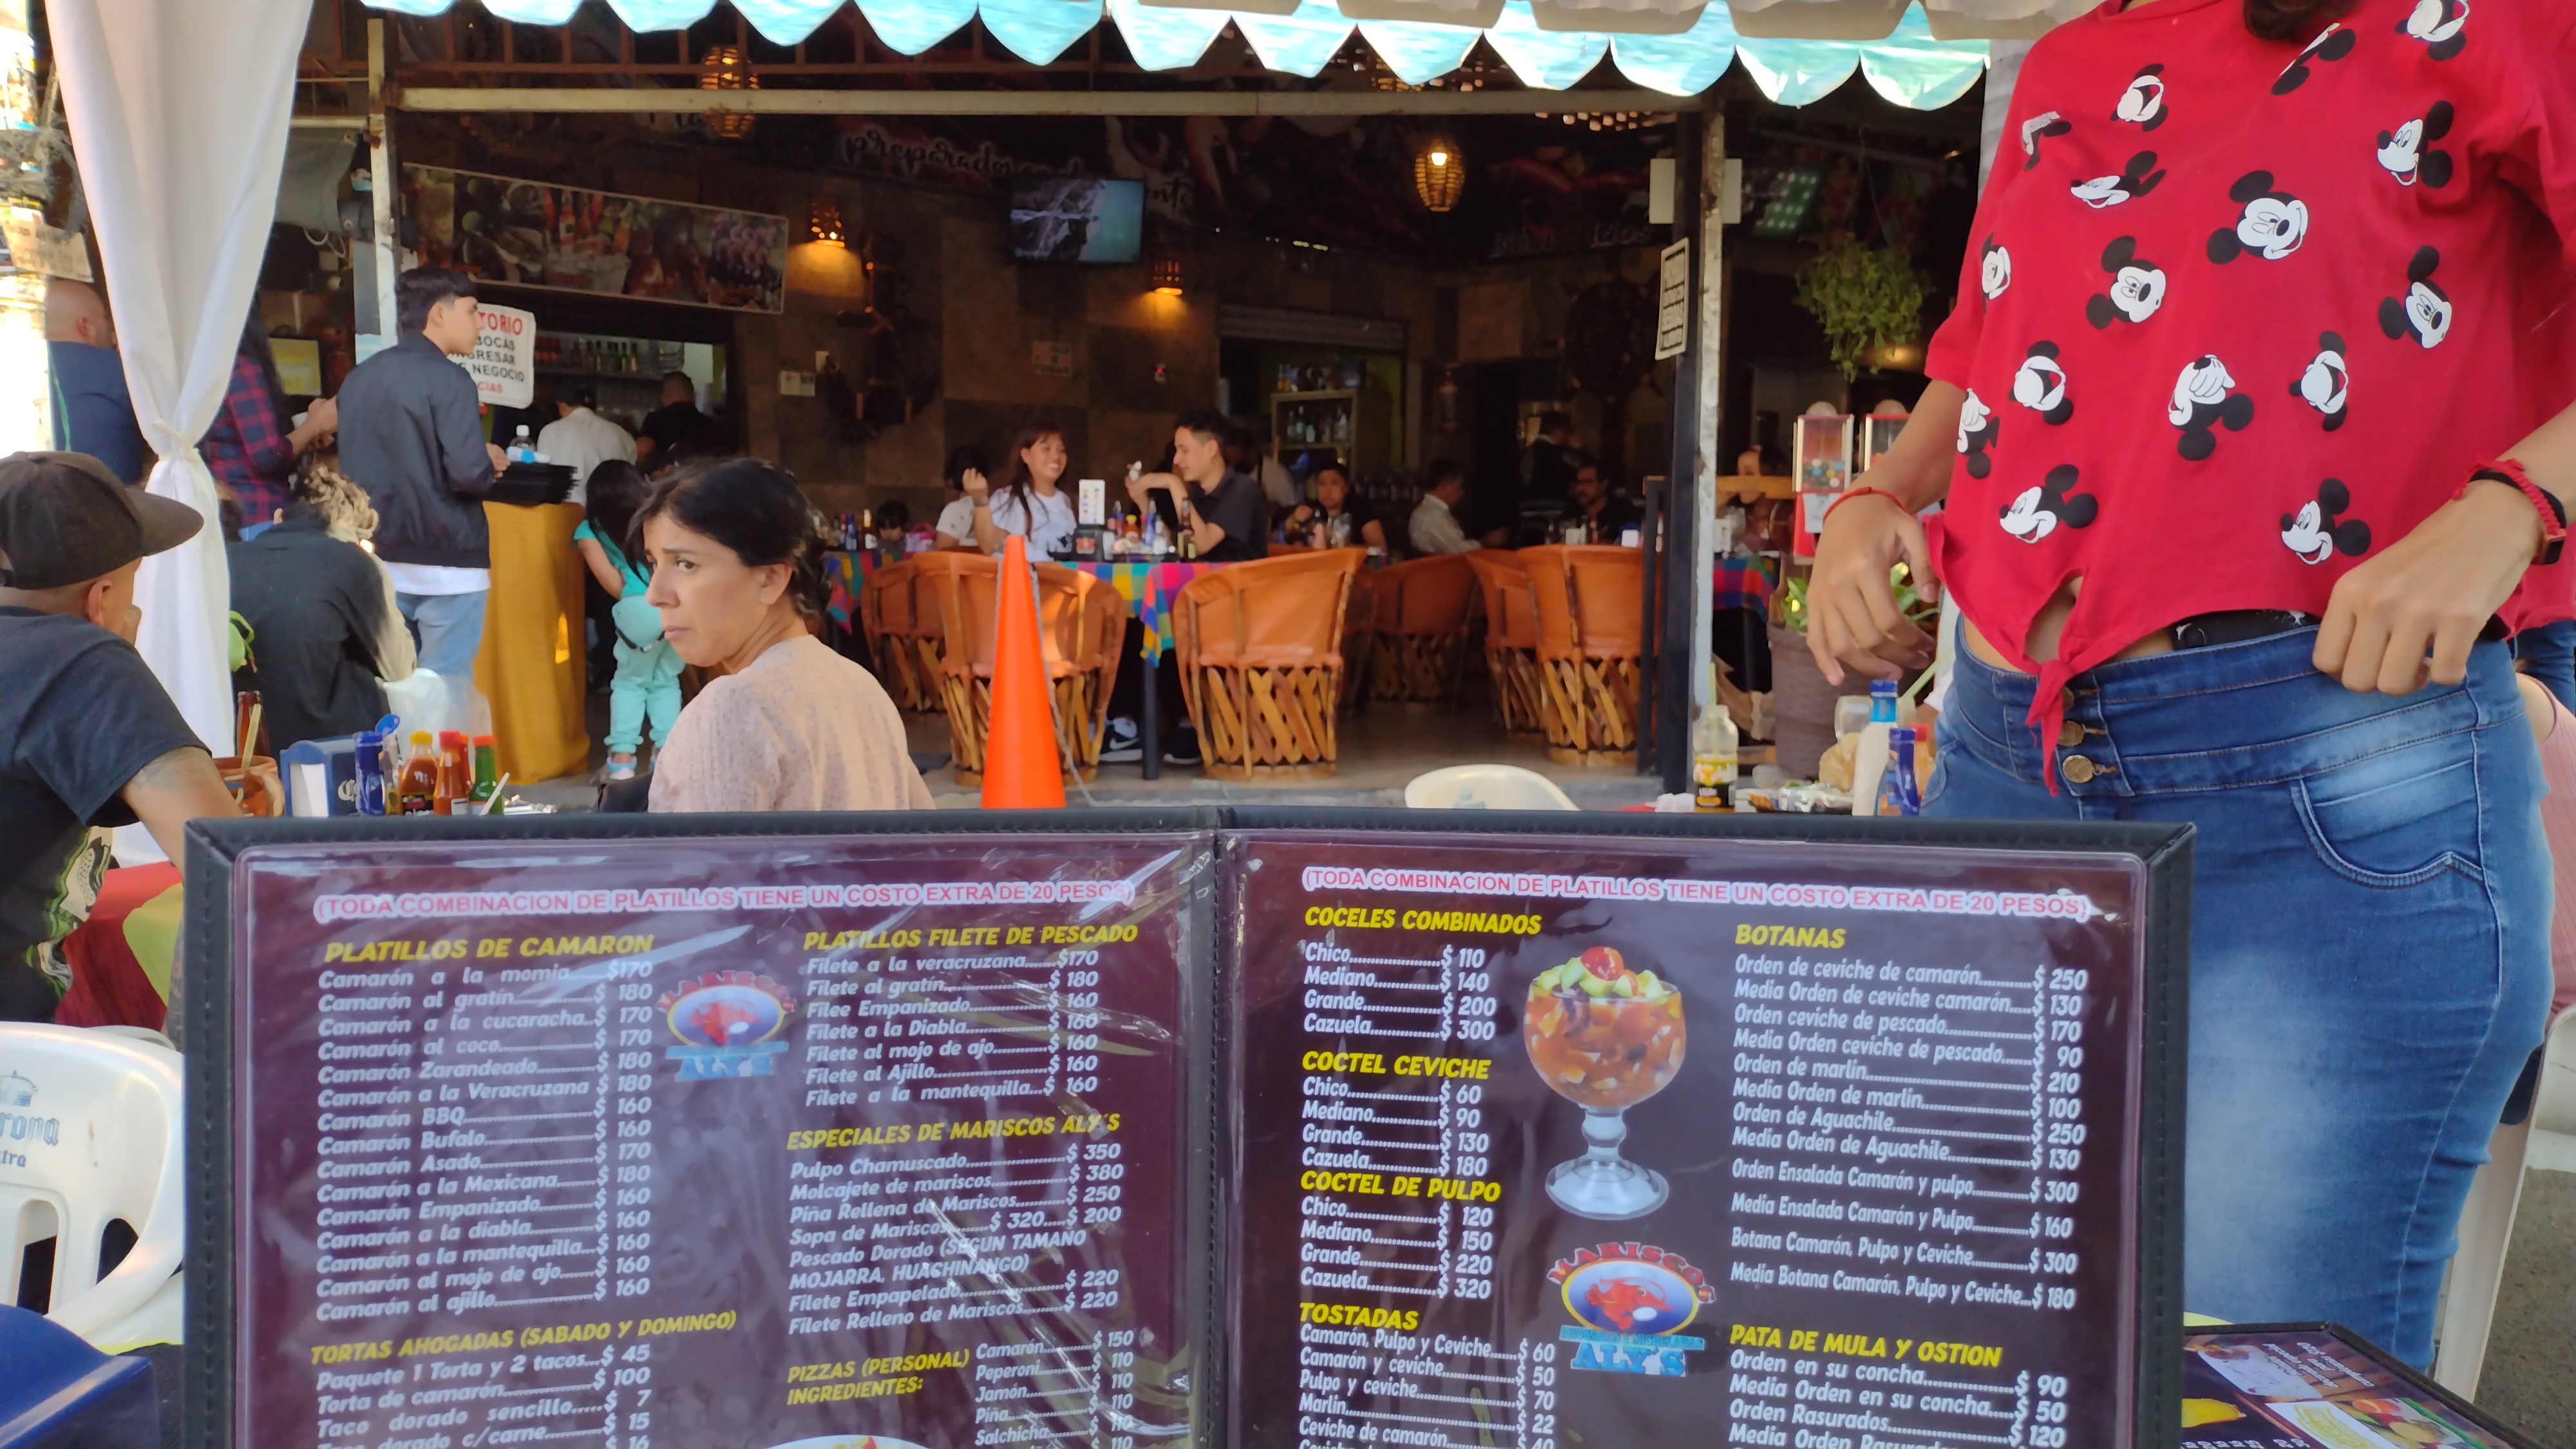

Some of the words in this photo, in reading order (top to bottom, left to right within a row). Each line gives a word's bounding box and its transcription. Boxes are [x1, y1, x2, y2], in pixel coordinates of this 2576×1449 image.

[473, 364, 524, 383] NEGOCIO
[319, 898, 392, 918] (TODA
[401, 895, 569, 913] COMBINACION
[580, 893, 607, 909] DE
[615, 891, 735, 908] PLATILLOS
[743, 889, 805, 906] TIENE
[811, 889, 838, 905] UN
[848, 887, 919, 904] COSTO
[927, 887, 993, 902] EXTRA
[998, 886, 1025, 901] DE
[1031, 886, 1054, 900] 20
[1306, 869, 1365, 889] (TODA
[1371, 872, 1510, 892] COMBINACION
[1518, 877, 1543, 893] DE
[1551, 878, 1660, 897] PLATILLOS
[1668, 883, 1727, 900] TIENE
[1735, 886, 1763, 902] UN
[1771, 887, 1846, 905] COSTO
[1853, 890, 1927, 907] EXTRA
[1935, 894, 1962, 909] DE
[1970, 895, 1994, 910] 20
[2002, 896, 2088, 918] PESOS)
[1305, 907, 1395, 928] COCELES
[1403, 911, 1541, 934] COMBINADOS
[1735, 924, 1846, 949] BOTANAS
[325, 939, 468, 963] PLATILLOS
[477, 938, 511, 958] DE
[520, 935, 654, 956] CAMARON
[804, 930, 921, 951] PLATILLOS
[929, 928, 997, 947] FILETE
[1006, 927, 1032, 945] DE
[1041, 925, 1138, 943] PESCADO
[1459, 949, 1484, 967] 110
[1735, 953, 1783, 975] Orden
[1788, 956, 1808, 976] de
[1813, 958, 1874, 979] ceviche
[1879, 960, 1900, 980] de
[807, 979, 857, 996] Filete
[865, 979, 883, 995] al
[1067, 972, 1098, 987] 180
[1457, 974, 1489, 991] 140
[1734, 979, 1783, 1001] Media
[1788, 981, 1837, 1003] Orden
[1842, 983, 1862, 1003] de
[1868, 986, 1929, 1009] ceviche
[2050, 995, 2081, 1016] 130
[807, 1002, 850, 1019] Filee
[318, 1065, 411, 1084] Camarón
[618, 1052, 652, 1069] 180
[1302, 1051, 1386, 1073] COCTEL
[1394, 1055, 1491, 1078] CEVICHE
[318, 1090, 412, 1108] Camarón
[418, 1088, 431, 1103] a
[440, 1084, 459, 1100] la
[469, 1079, 589, 1099] Veracruzana
[618, 1075, 652, 1092] 180
[1456, 1084, 1481, 1104] 60
[788, 1125, 910, 1150] ESPECIALES
[918, 1122, 942, 1141] DE
[950, 1117, 1055, 1139] MARISCOS
[0, 1150, 26, 1168] tra
[791, 1162, 843, 1182] Pulpo
[1083, 1144, 1121, 1159] 350
[790, 1181, 878, 1203] Molcajete
[886, 1178, 907, 1194] de
[1082, 1165, 1123, 1180] 380
[1301, 1171, 1383, 1194] COCTEL
[1392, 1175, 1420, 1196] DE
[1427, 1177, 1501, 1202] PULPO
[1732, 1159, 1774, 1180] Orden
[1778, 1162, 1843, 1186] Ensalada
[1848, 1166, 1914, 1191] Camarón
[1919, 1173, 1929, 1195] y
[2045, 1181, 2079, 1203] 300
[790, 1204, 832, 1223] Piña
[838, 1199, 907, 1220] Rellena
[1083, 1187, 1121, 1202] 250
[790, 1245, 865, 1268] Pescado
[873, 1243, 933, 1262] Dorado
[1012, 1227, 1086, 1249] TAMAÑO
[1462, 1231, 1492, 1251] 150
[1731, 1227, 1781, 1251] Botana
[1786, 1232, 1853, 1258] Camarón,
[1858, 1236, 1899, 1263] Pulpo
[1904, 1244, 1913, 1265] y
[2044, 1251, 2079, 1274] 300
[316, 1278, 410, 1296] Camarón
[417, 1273, 437, 1289] al
[446, 1268, 493, 1289] mojo
[501, 1265, 524, 1282] de
[615, 1257, 649, 1274] 160
[789, 1316, 840, 1334] Filete
[847, 1310, 914, 1331] Relleno
[921, 1307, 941, 1323] de
[1081, 1291, 1117, 1307] 220
[1300, 1302, 1419, 1330] TOSTADAS
[311, 1341, 392, 1364] TORTAS
[399, 1331, 513, 1356] AHOGADAS
[521, 1323, 611, 1348] (SABADO
[618, 1319, 633, 1337] Y
[638, 1311, 736, 1336] DOMINGO)
[1108, 1331, 1133, 1347] 150
[1300, 1323, 1368, 1349] Camarón,
[1374, 1329, 1415, 1352] Pulpo
[1421, 1338, 1430, 1354] y
[1533, 1343, 1555, 1363] 60
[1730, 1325, 1782, 1348] PATA
[1789, 1330, 1819, 1352] DE
[1823, 1332, 1886, 1358] MULA
[1895, 1338, 1912, 1359] Y
[1918, 1341, 2002, 1367] OSTION
[317, 1368, 404, 1390] Paquete
[413, 1365, 421, 1381] 1
[431, 1361, 482, 1380] Torta
[491, 1361, 501, 1378] y
[511, 1356, 524, 1372] 2
[621, 1345, 649, 1361] 45
[788, 1360, 855, 1383] PIZZAS
[862, 1349, 970, 1376] (PERSONAL)
[787, 1377, 923, 1405] INGREDIENTES:
